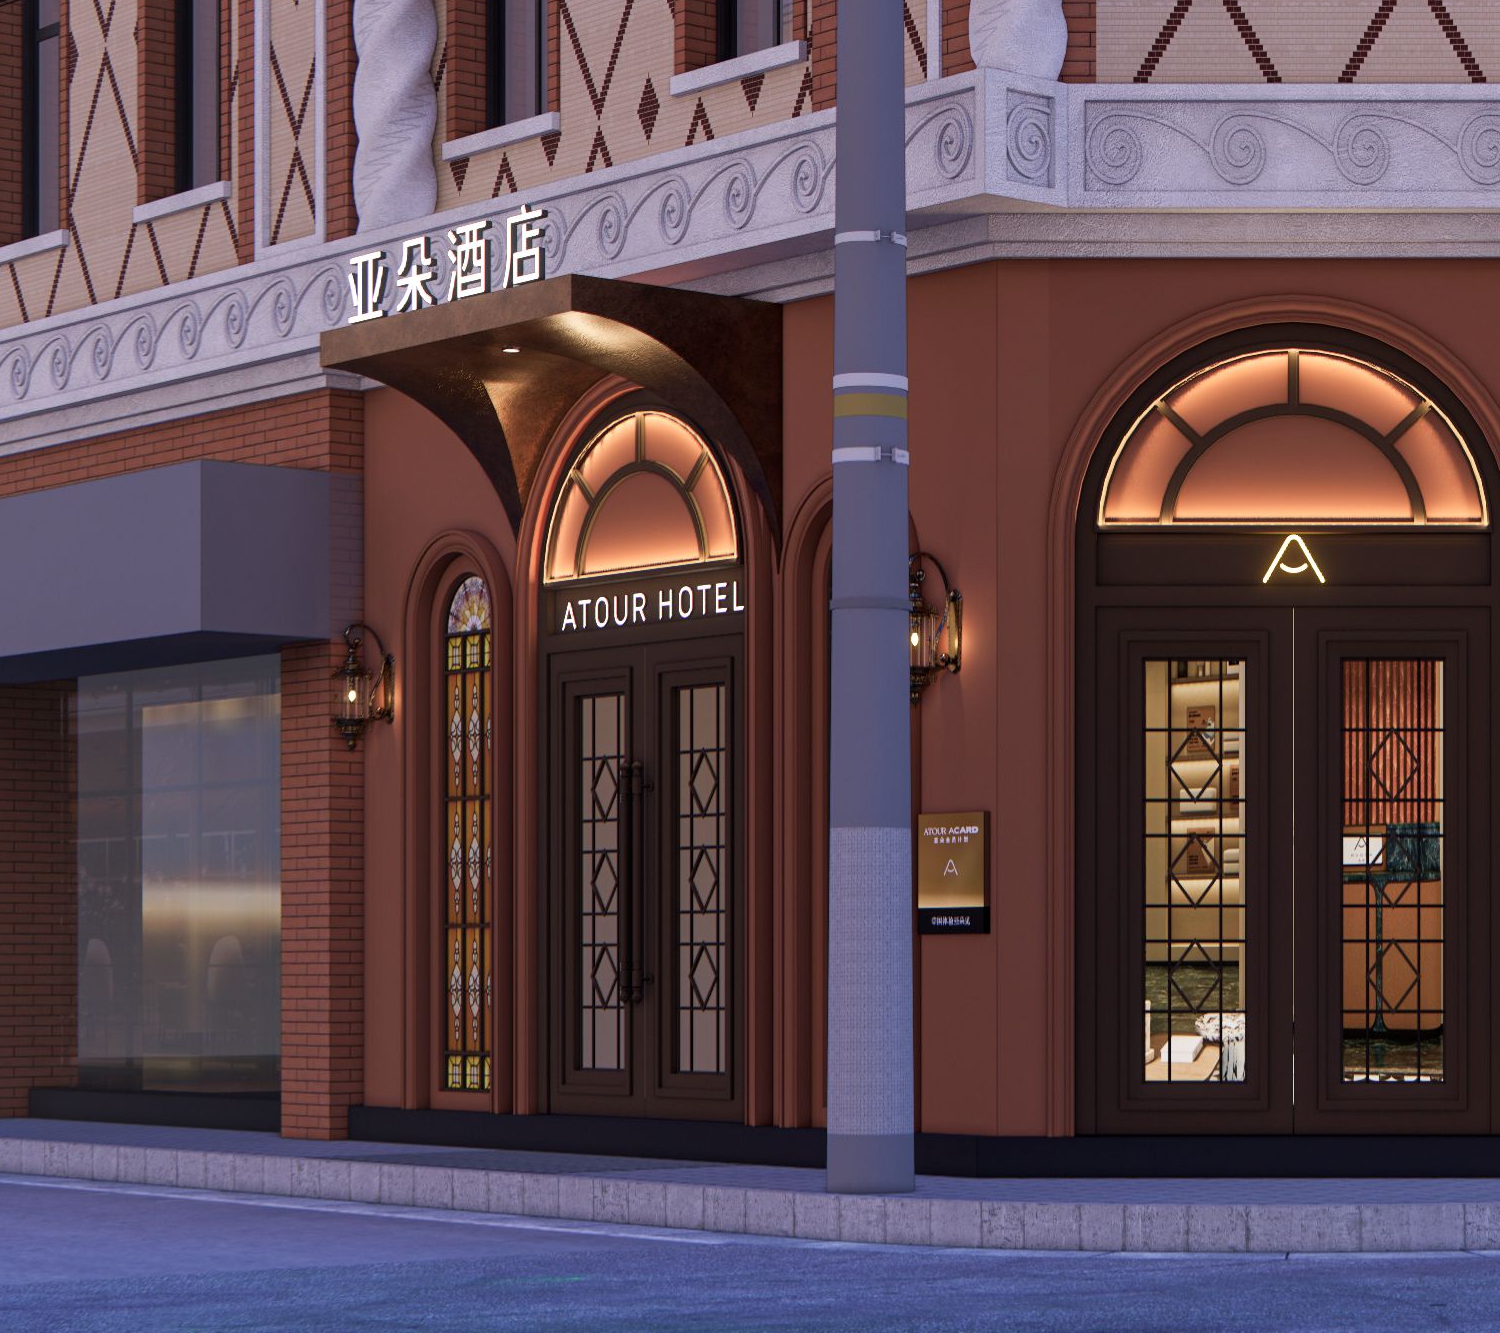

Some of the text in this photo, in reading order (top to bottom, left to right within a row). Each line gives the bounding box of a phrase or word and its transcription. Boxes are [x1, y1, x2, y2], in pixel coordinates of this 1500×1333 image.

[348, 203, 547, 324] 亚朵酒店
[561, 580, 745, 632] ATOUR HOTEL
[923, 825, 979, 836] ATOUR ACARD
